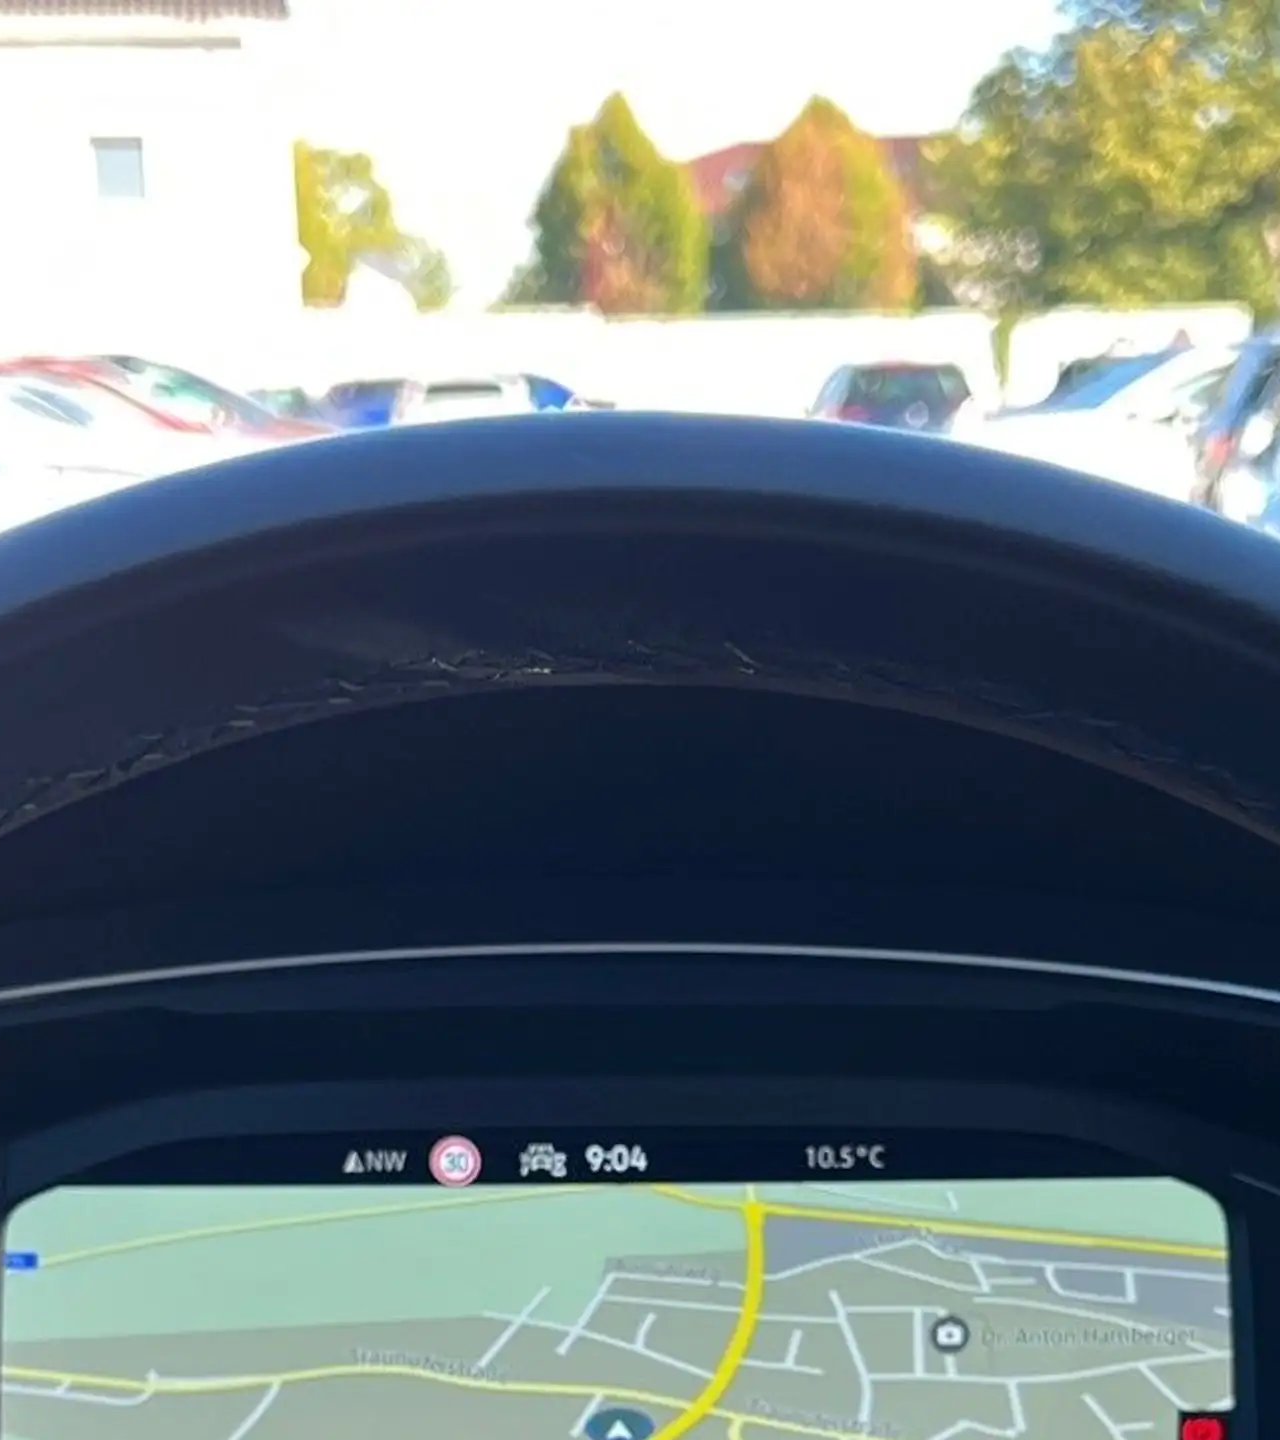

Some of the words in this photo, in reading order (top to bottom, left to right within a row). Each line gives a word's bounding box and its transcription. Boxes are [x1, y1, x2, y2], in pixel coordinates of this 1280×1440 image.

[365, 1150, 407, 1173] NW
[444, 1152, 470, 1173] 30
[585, 1144, 648, 1173] 9:04
[805, 1145, 886, 1169] 10.5°C
